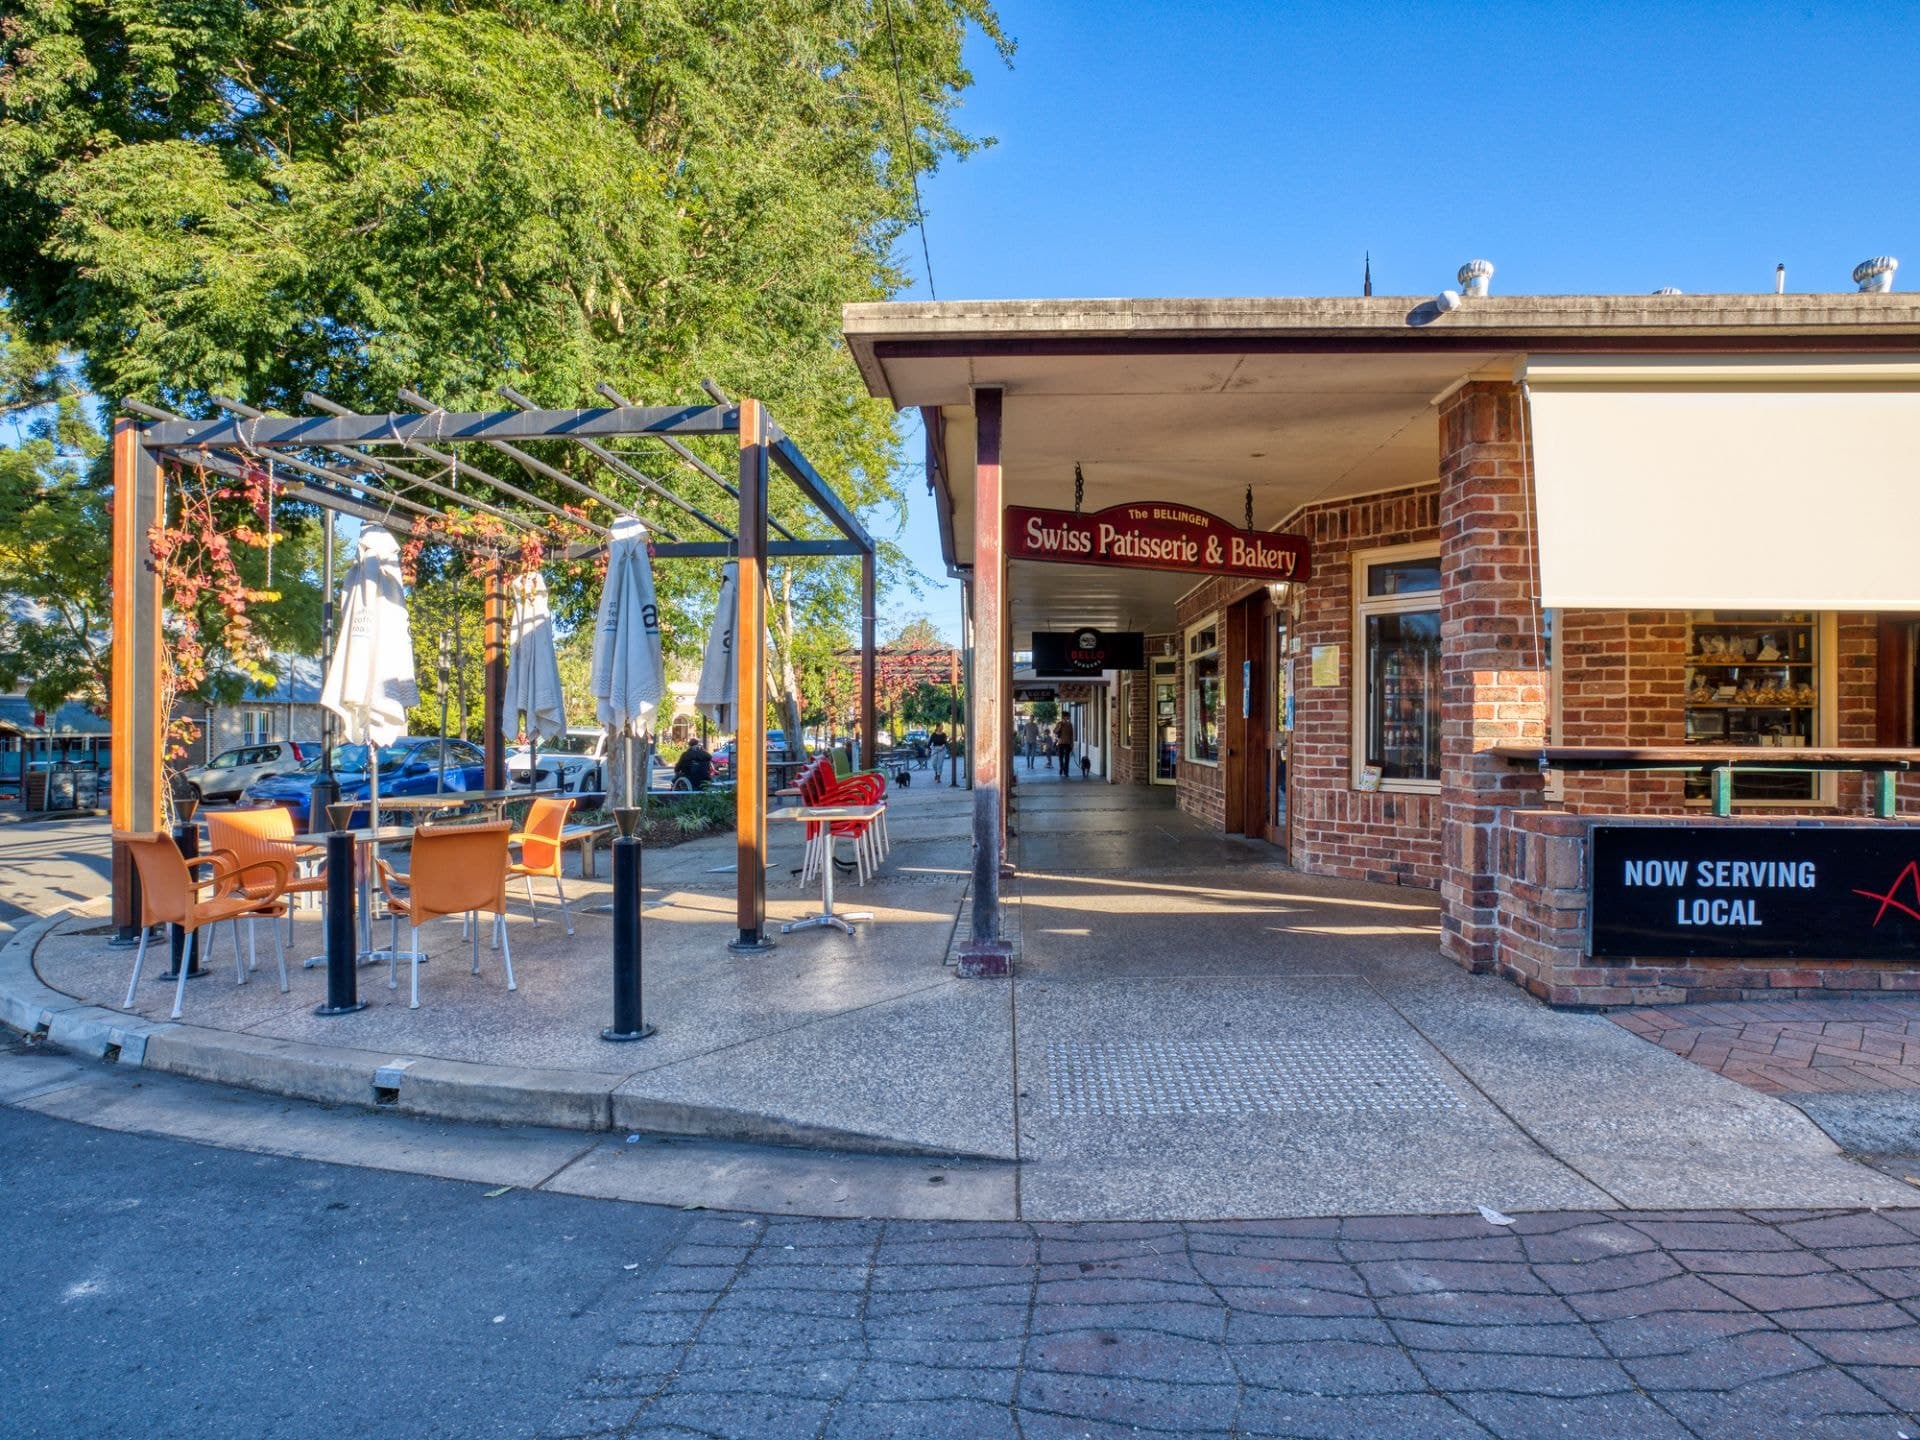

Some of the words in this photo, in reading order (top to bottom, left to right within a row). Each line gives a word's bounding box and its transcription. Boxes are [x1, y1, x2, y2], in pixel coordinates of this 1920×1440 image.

[1128, 508, 1148, 520] The
[1153, 508, 1209, 528] BELLINGEN
[1026, 516, 1092, 553] Swiss
[1098, 523, 1199, 562] Patisserie
[1205, 534, 1224, 565] &
[1231, 537, 1297, 577] Bakery
[1071, 650, 1105, 660] BELLO
[1625, 860, 1689, 887] NOW
[1697, 860, 1816, 888] SERVING
[1677, 898, 1763, 926] LOCAL
